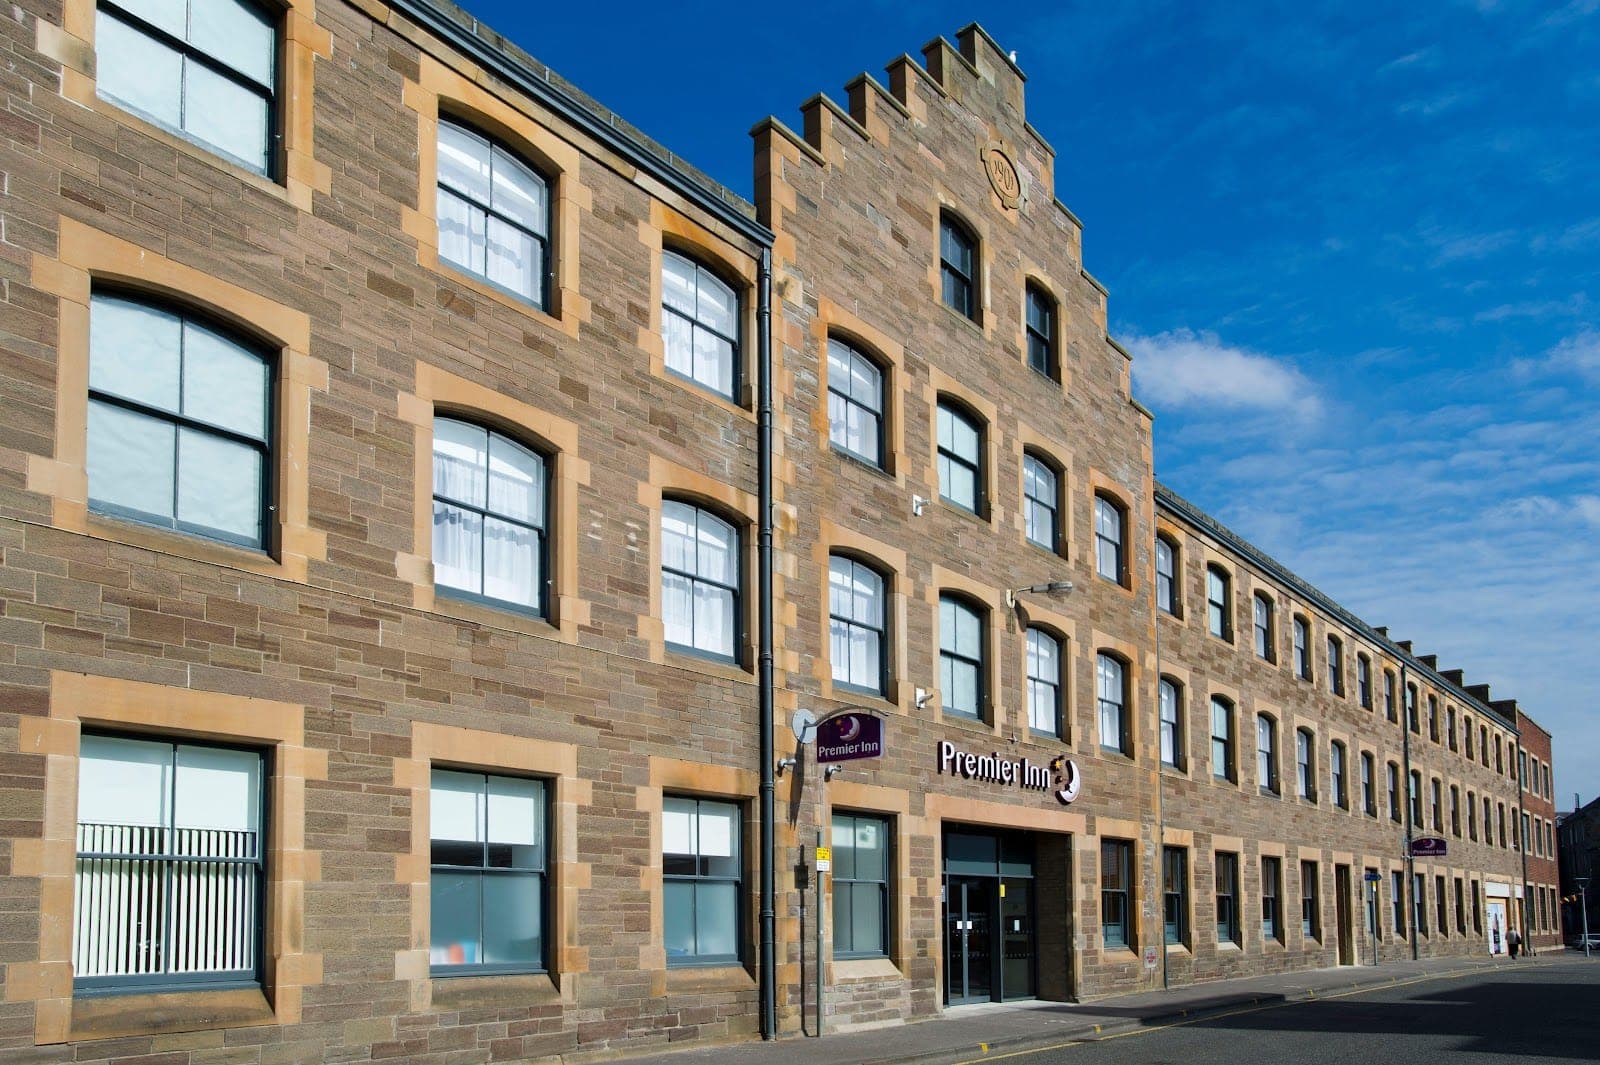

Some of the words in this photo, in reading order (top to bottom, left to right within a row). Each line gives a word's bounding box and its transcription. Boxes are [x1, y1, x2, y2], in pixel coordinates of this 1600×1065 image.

[818, 743, 860, 757] Premier
[861, 741, 879, 752] Inn
[940, 741, 1020, 783] Premier
[1023, 758, 1052, 789] Inn
